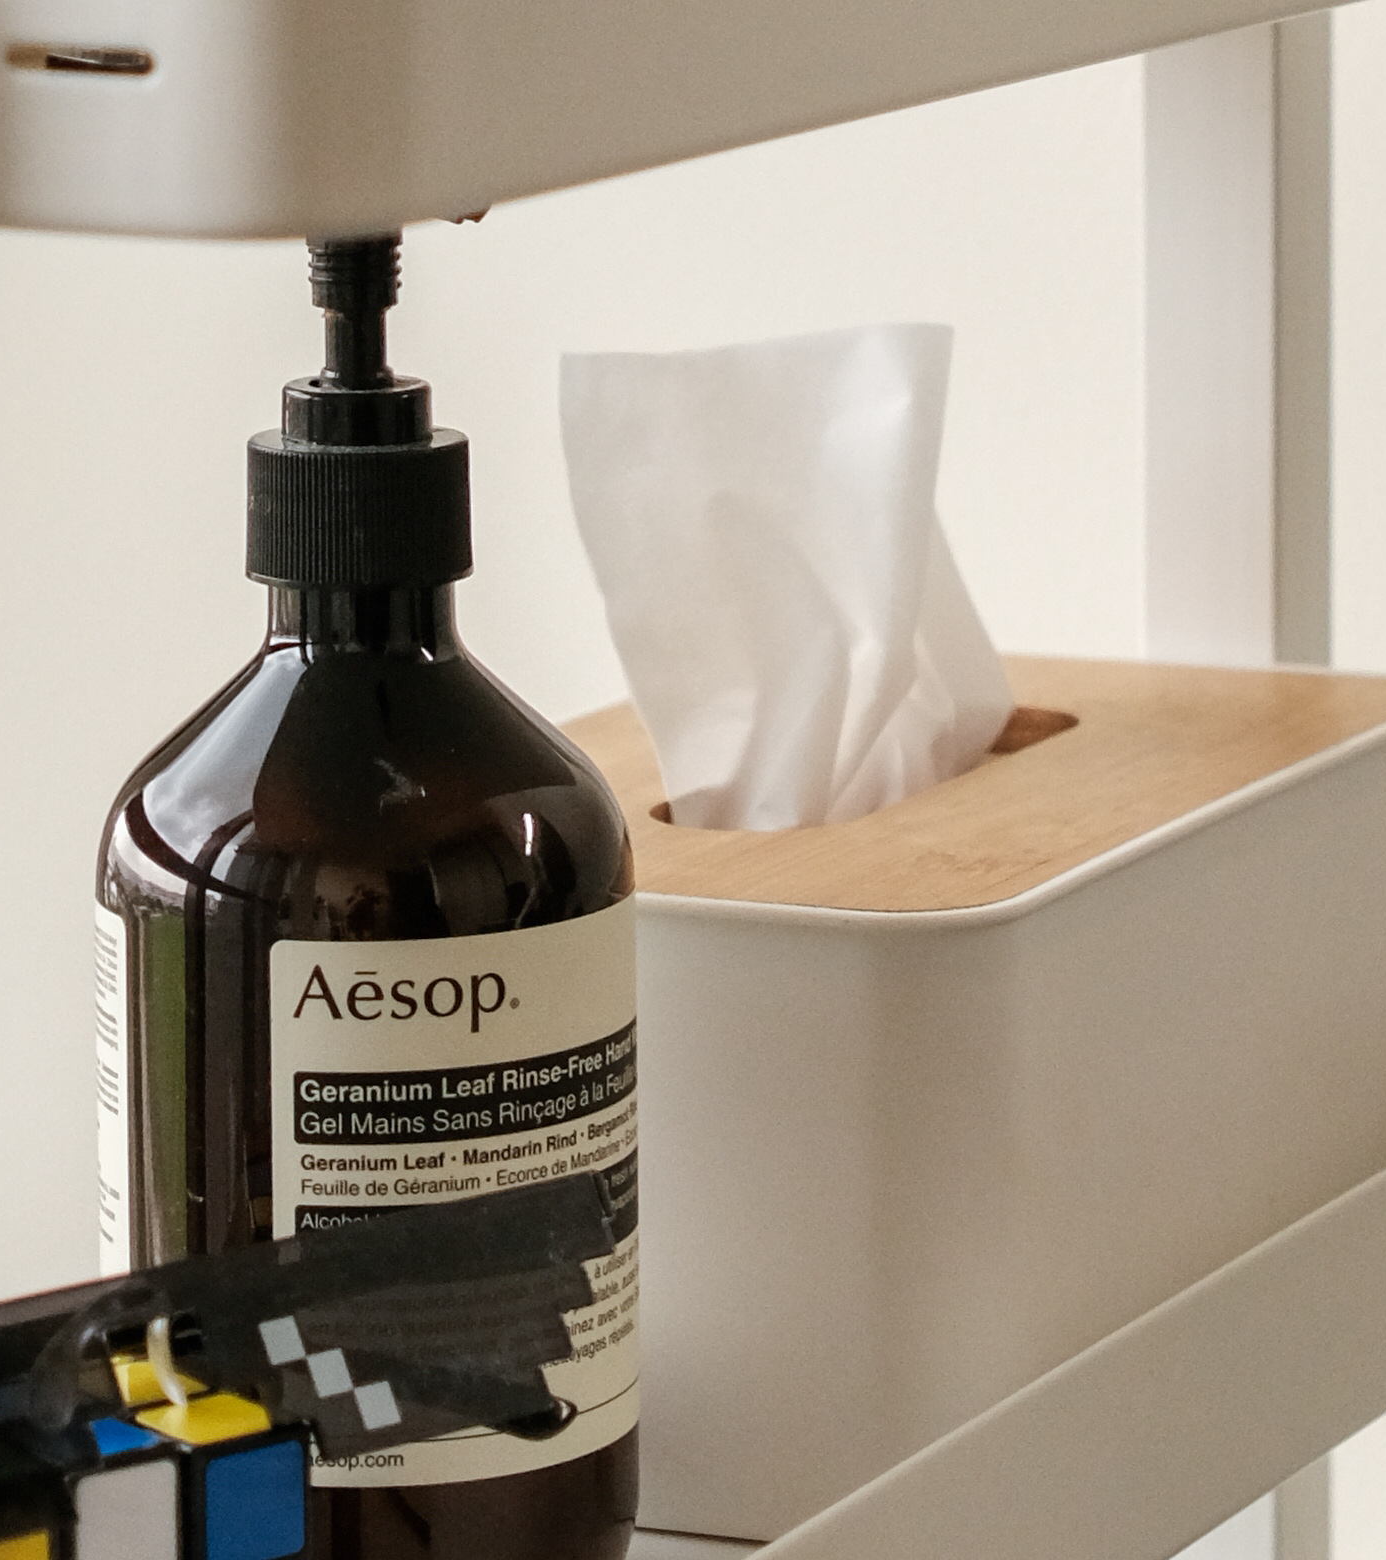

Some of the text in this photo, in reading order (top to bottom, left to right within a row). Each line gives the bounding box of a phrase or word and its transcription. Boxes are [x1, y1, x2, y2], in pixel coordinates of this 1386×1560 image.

[300, 1079, 432, 1103] Geranium
[441, 1072, 495, 1099] Leaf
[502, 1054, 603, 1092] Rinse-Free
[300, 1111, 343, 1135] Gel
[351, 1112, 426, 1135] Mains
[432, 1109, 493, 1131] Sans
[499, 1093, 577, 1125] Rinçage
[580, 1084, 589, 1107] à
[592, 1081, 604, 1104] la
[300, 1154, 397, 1172] Geranium
[404, 1151, 445, 1170] Leaf
[463, 1140, 542, 1166] Mandarin
[546, 1130, 577, 1152] Rind
[301, 1179, 361, 1196] Feuille
[365, 1180, 388, 1196] de
[394, 1176, 481, 1196] Géranium
[496, 1166, 548, 1186] Ecorce
[551, 1160, 568, 1176] de
